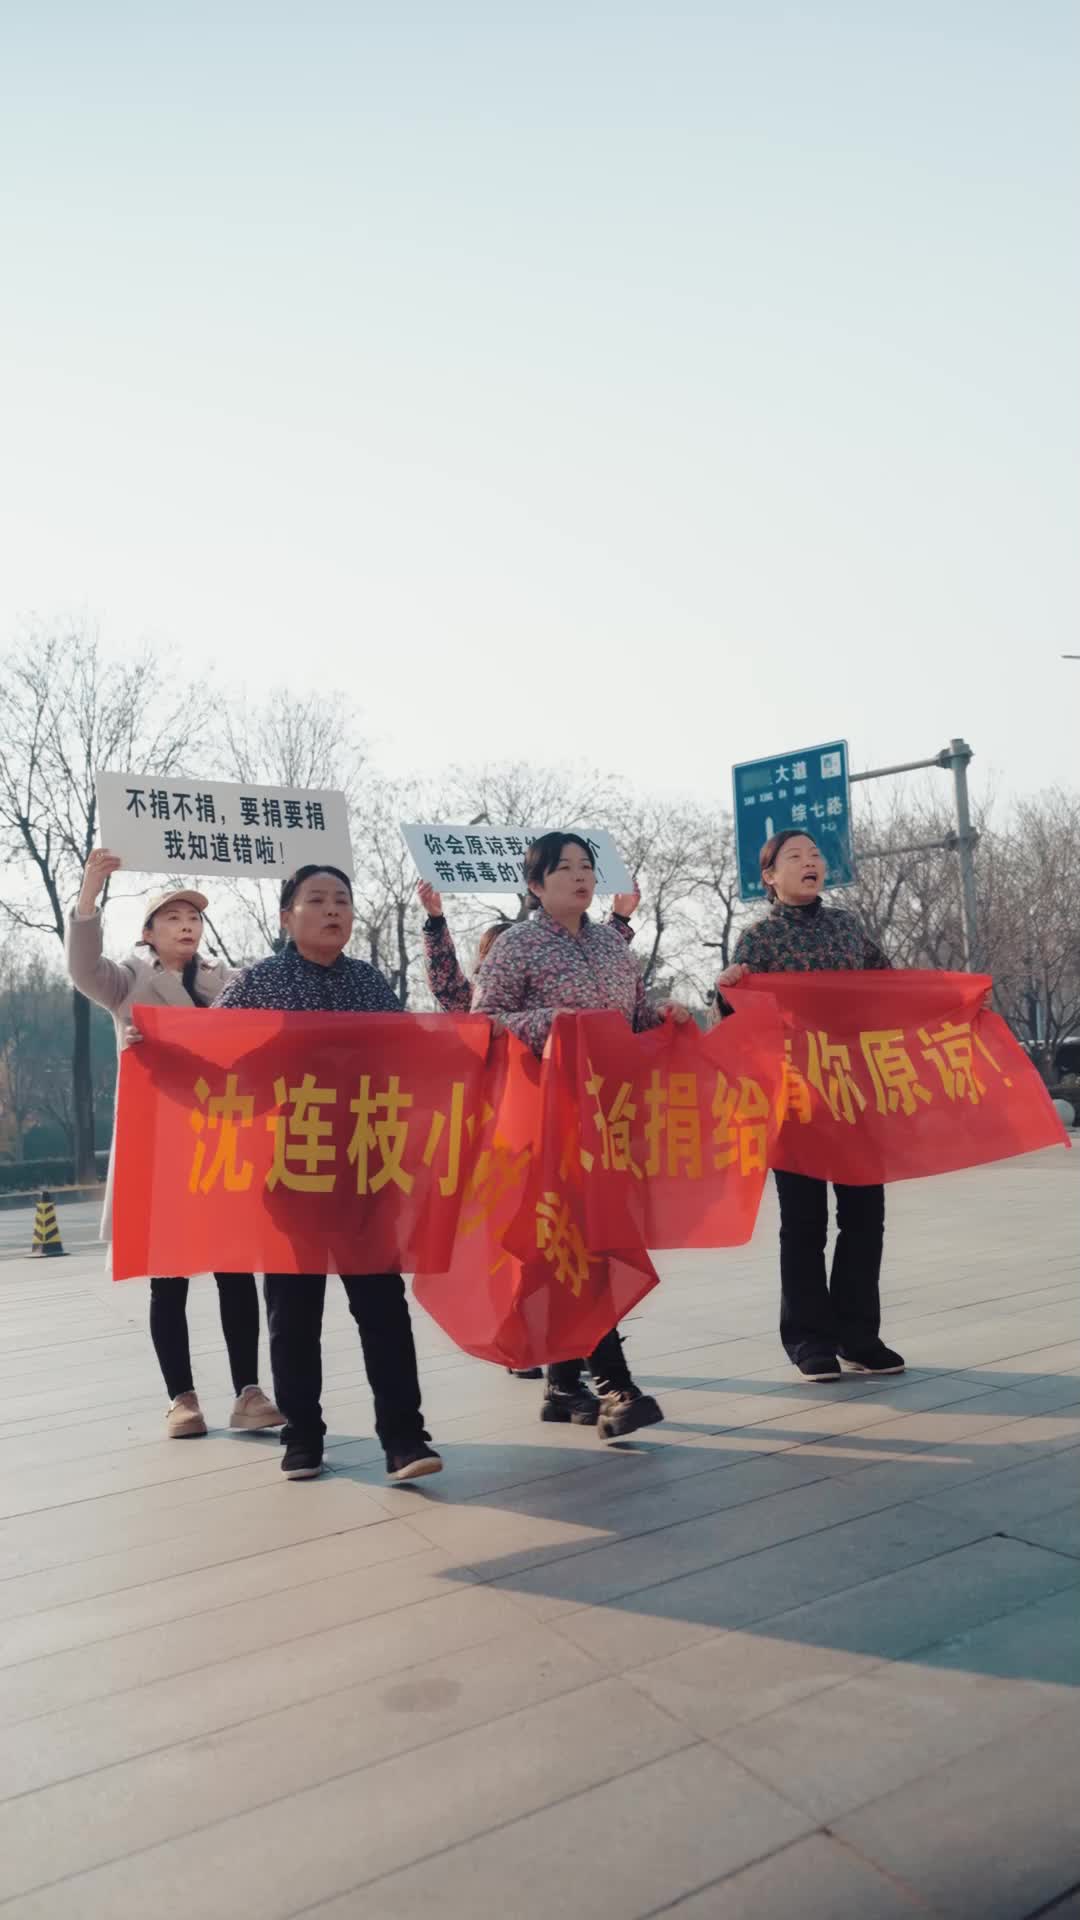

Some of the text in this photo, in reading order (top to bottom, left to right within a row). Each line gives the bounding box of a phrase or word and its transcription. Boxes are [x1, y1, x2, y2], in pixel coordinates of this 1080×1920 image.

[775, 761, 808, 784] 大道
[126, 788, 326, 831] 不捐不捐，要捐要捐
[164, 829, 286, 865] 我知道错啦！
